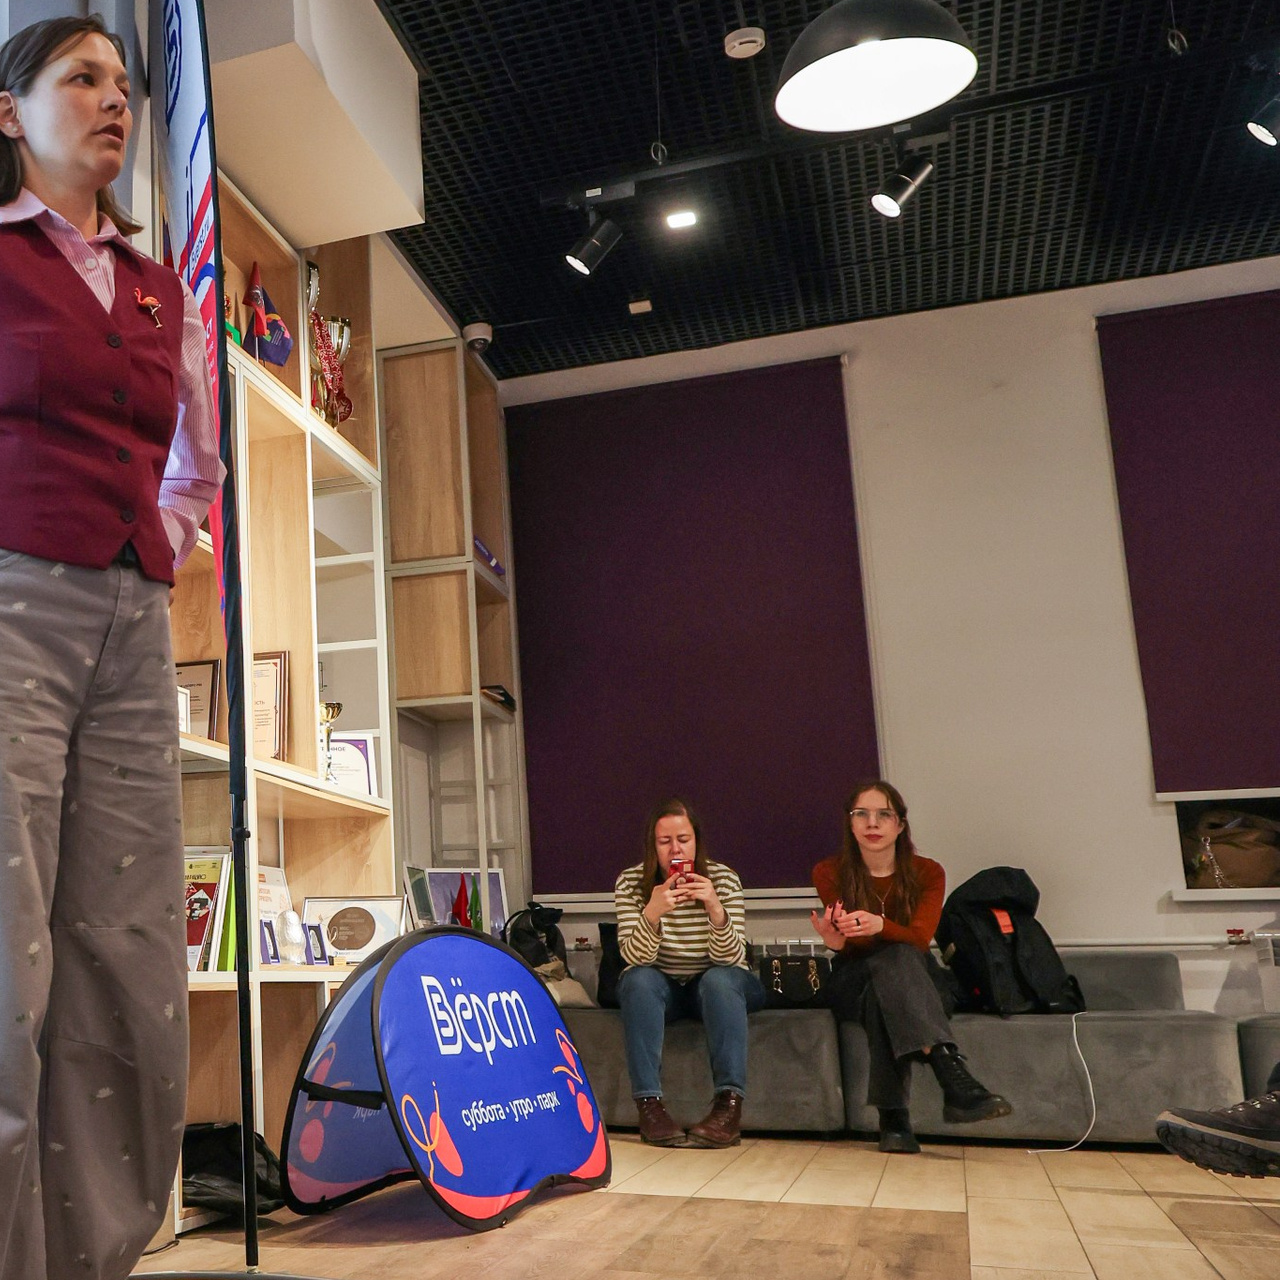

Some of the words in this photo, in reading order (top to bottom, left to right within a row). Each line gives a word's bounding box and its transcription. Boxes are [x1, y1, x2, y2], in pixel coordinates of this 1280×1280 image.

[461, 1099, 506, 1131] суббота
[509, 1097, 534, 1123] утро
[537, 1091, 561, 1113] парк
